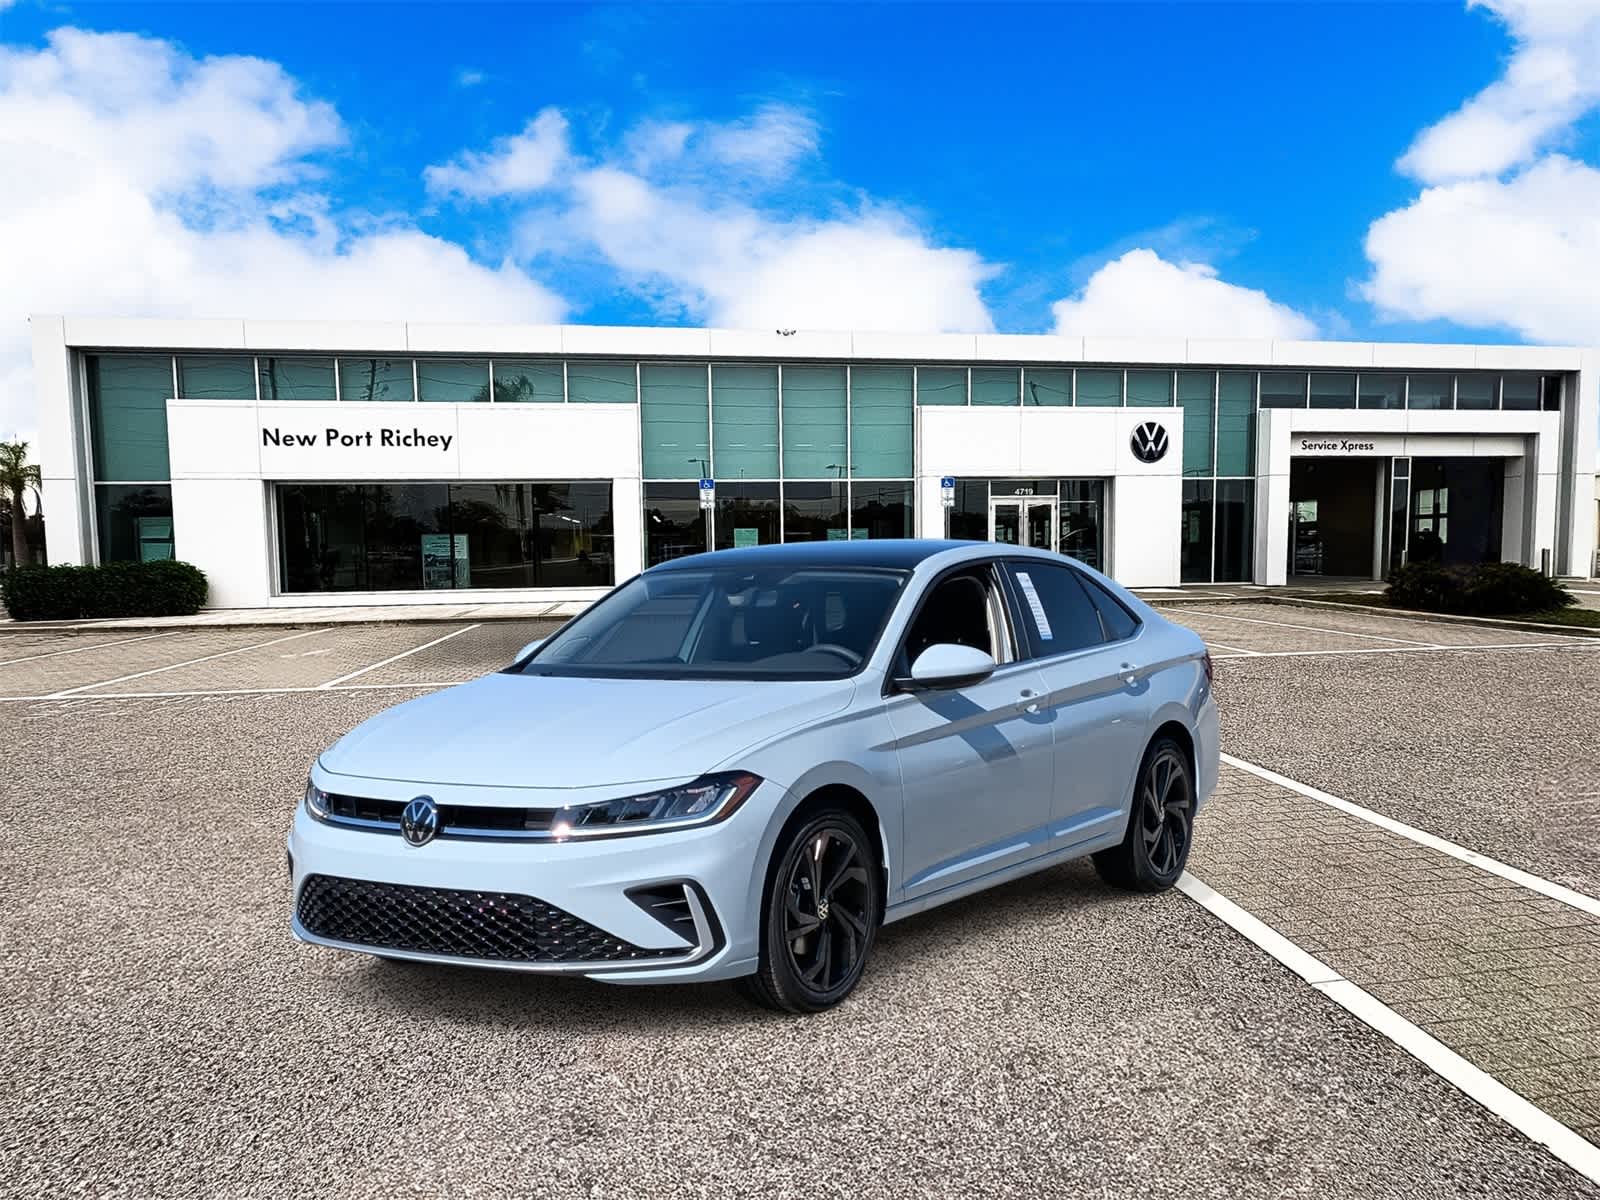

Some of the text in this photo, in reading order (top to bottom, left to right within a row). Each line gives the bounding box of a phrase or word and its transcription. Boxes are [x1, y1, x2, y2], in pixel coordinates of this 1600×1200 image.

[262, 428, 453, 451] New Port Richey
[1131, 421, 1168, 462] VW
[1301, 439, 1374, 452] Service Xpress
